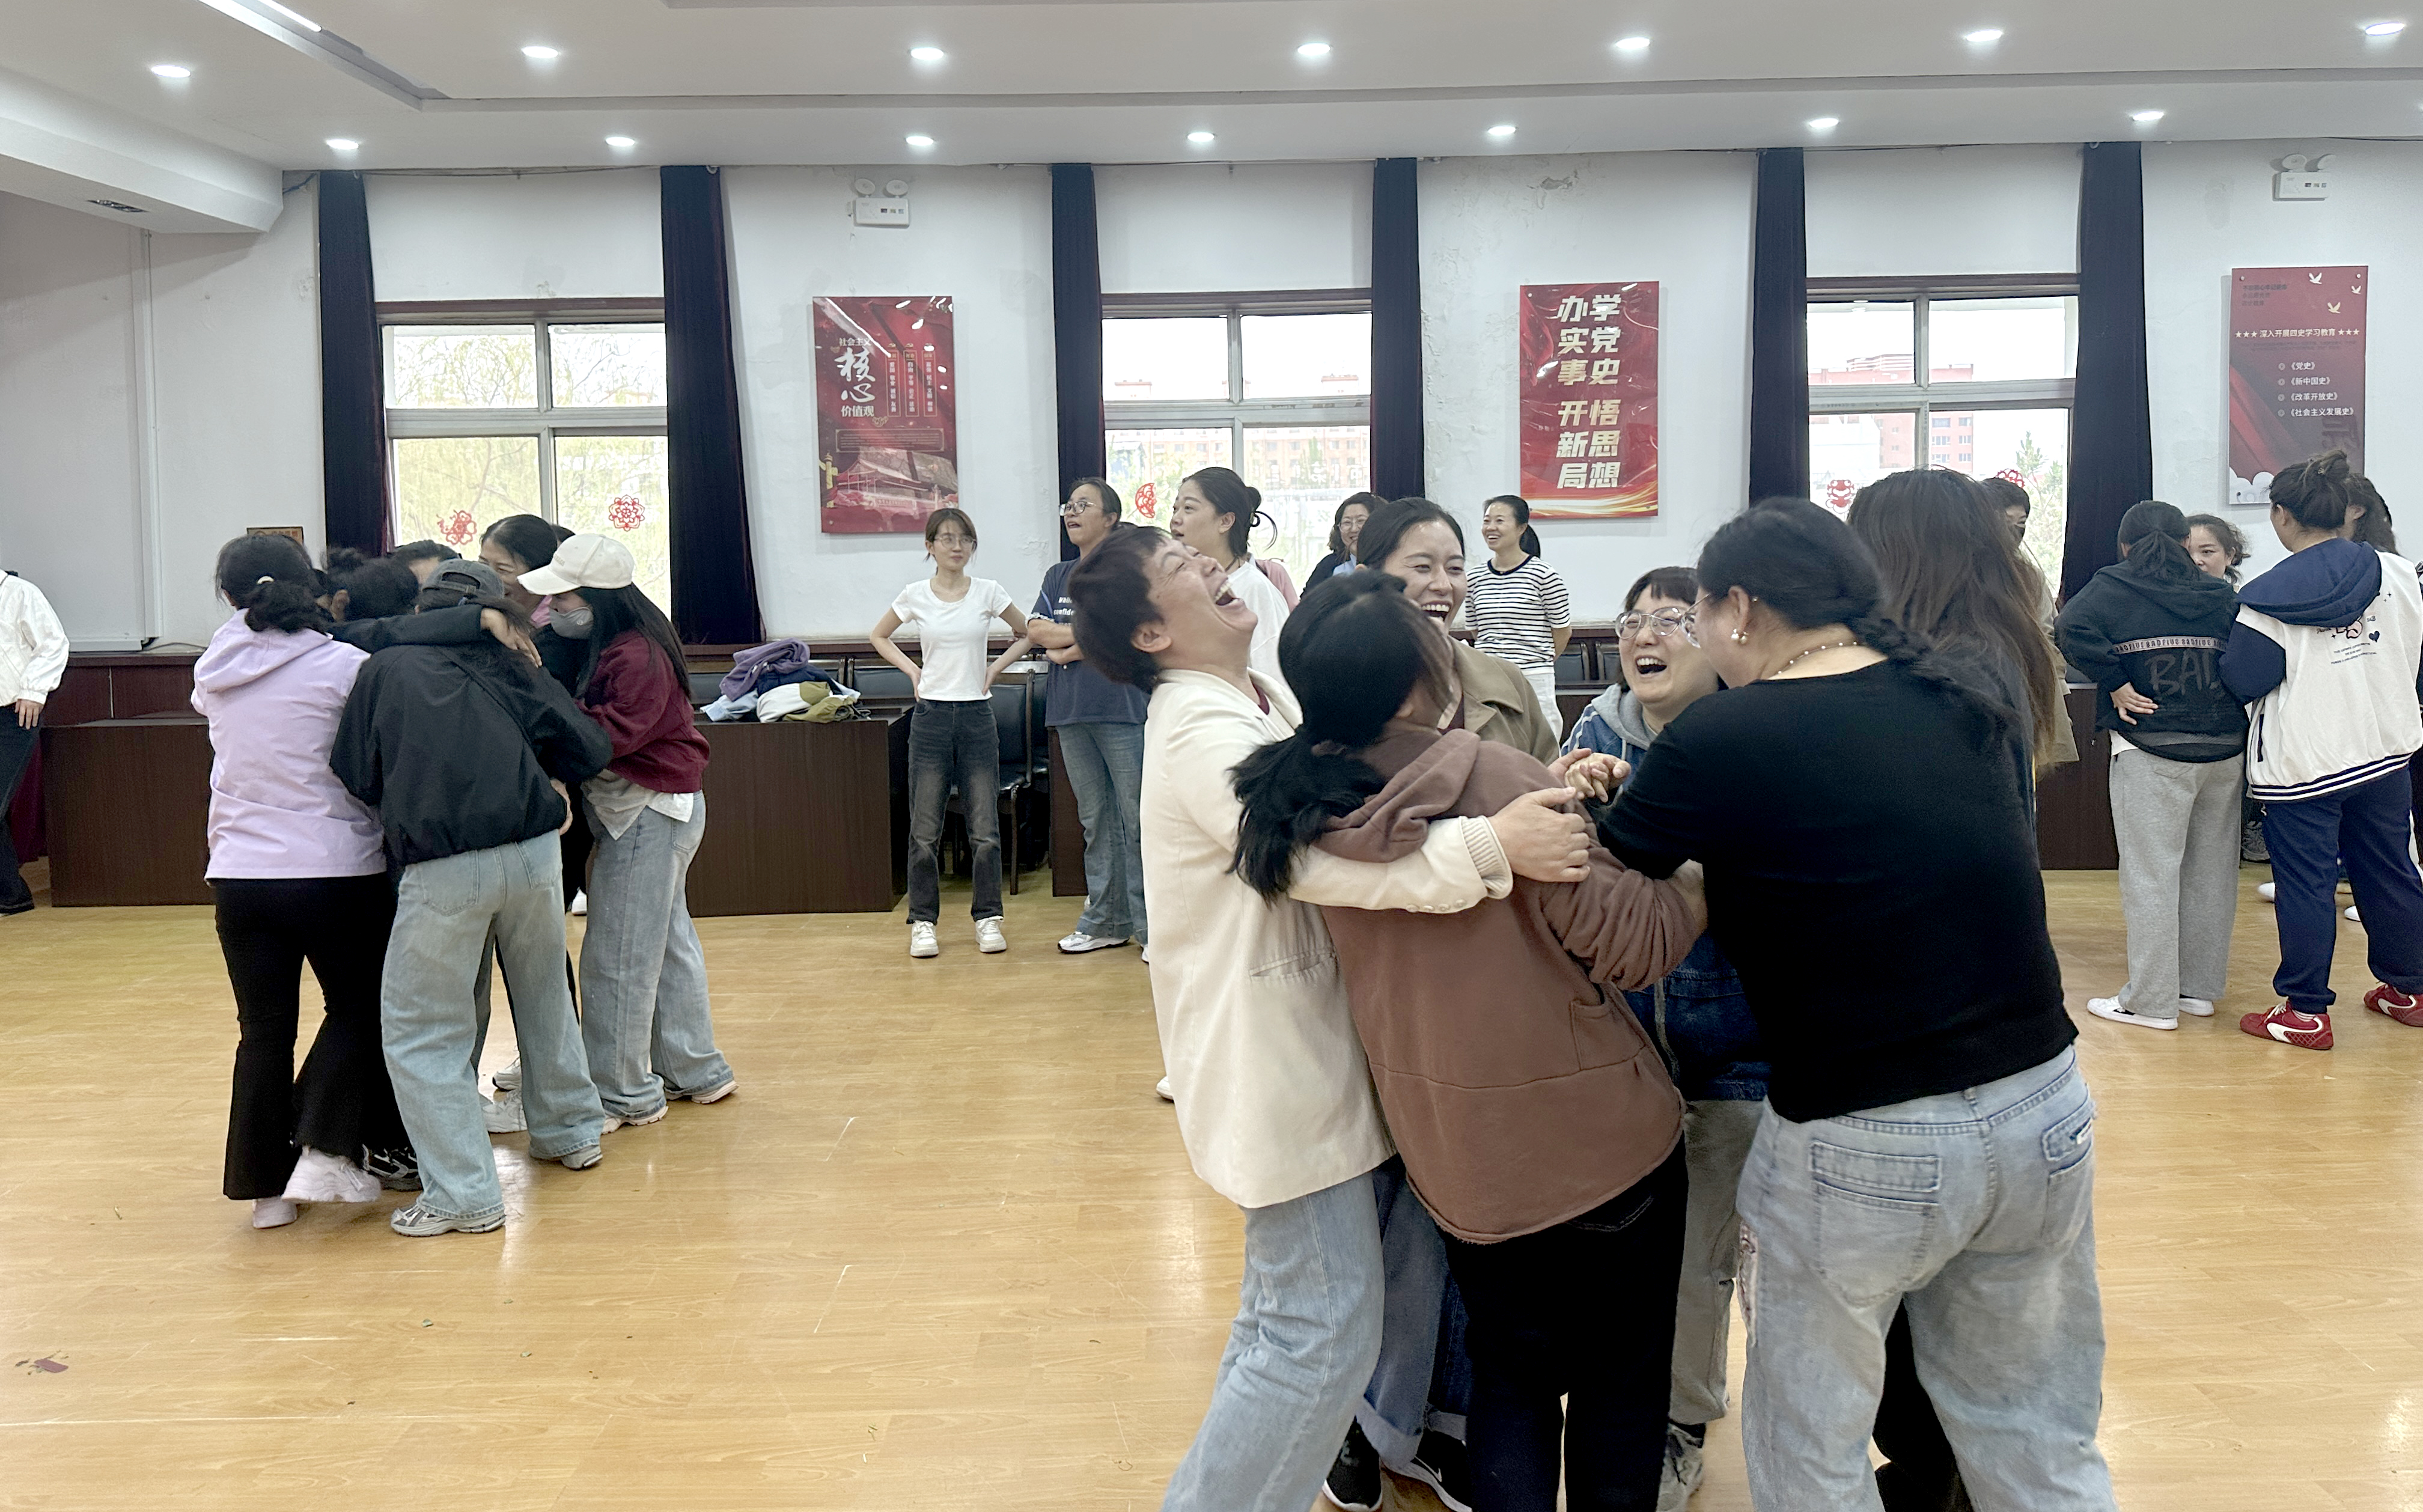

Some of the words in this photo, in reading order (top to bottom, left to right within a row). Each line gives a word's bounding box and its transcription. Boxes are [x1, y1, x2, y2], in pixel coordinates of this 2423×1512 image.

[2260, 328, 2336, 338] 深入开展四史学习教育
[839, 337, 872, 347] 社会主义
[1556, 295, 1589, 386] 办实事
[1588, 293, 1622, 385] 学党史
[2291, 361, 2315, 370] 《党史》
[834, 346, 876, 403] 核心
[2291, 376, 2330, 385] 《新中国史》
[2290, 392, 2338, 401] 《改革开放史》
[841, 405, 874, 417] 价值观
[2290, 407, 2354, 417] 《社会主义发展史》
[1555, 400, 1589, 489] 开新局
[1588, 399, 1622, 489] 悟思想
